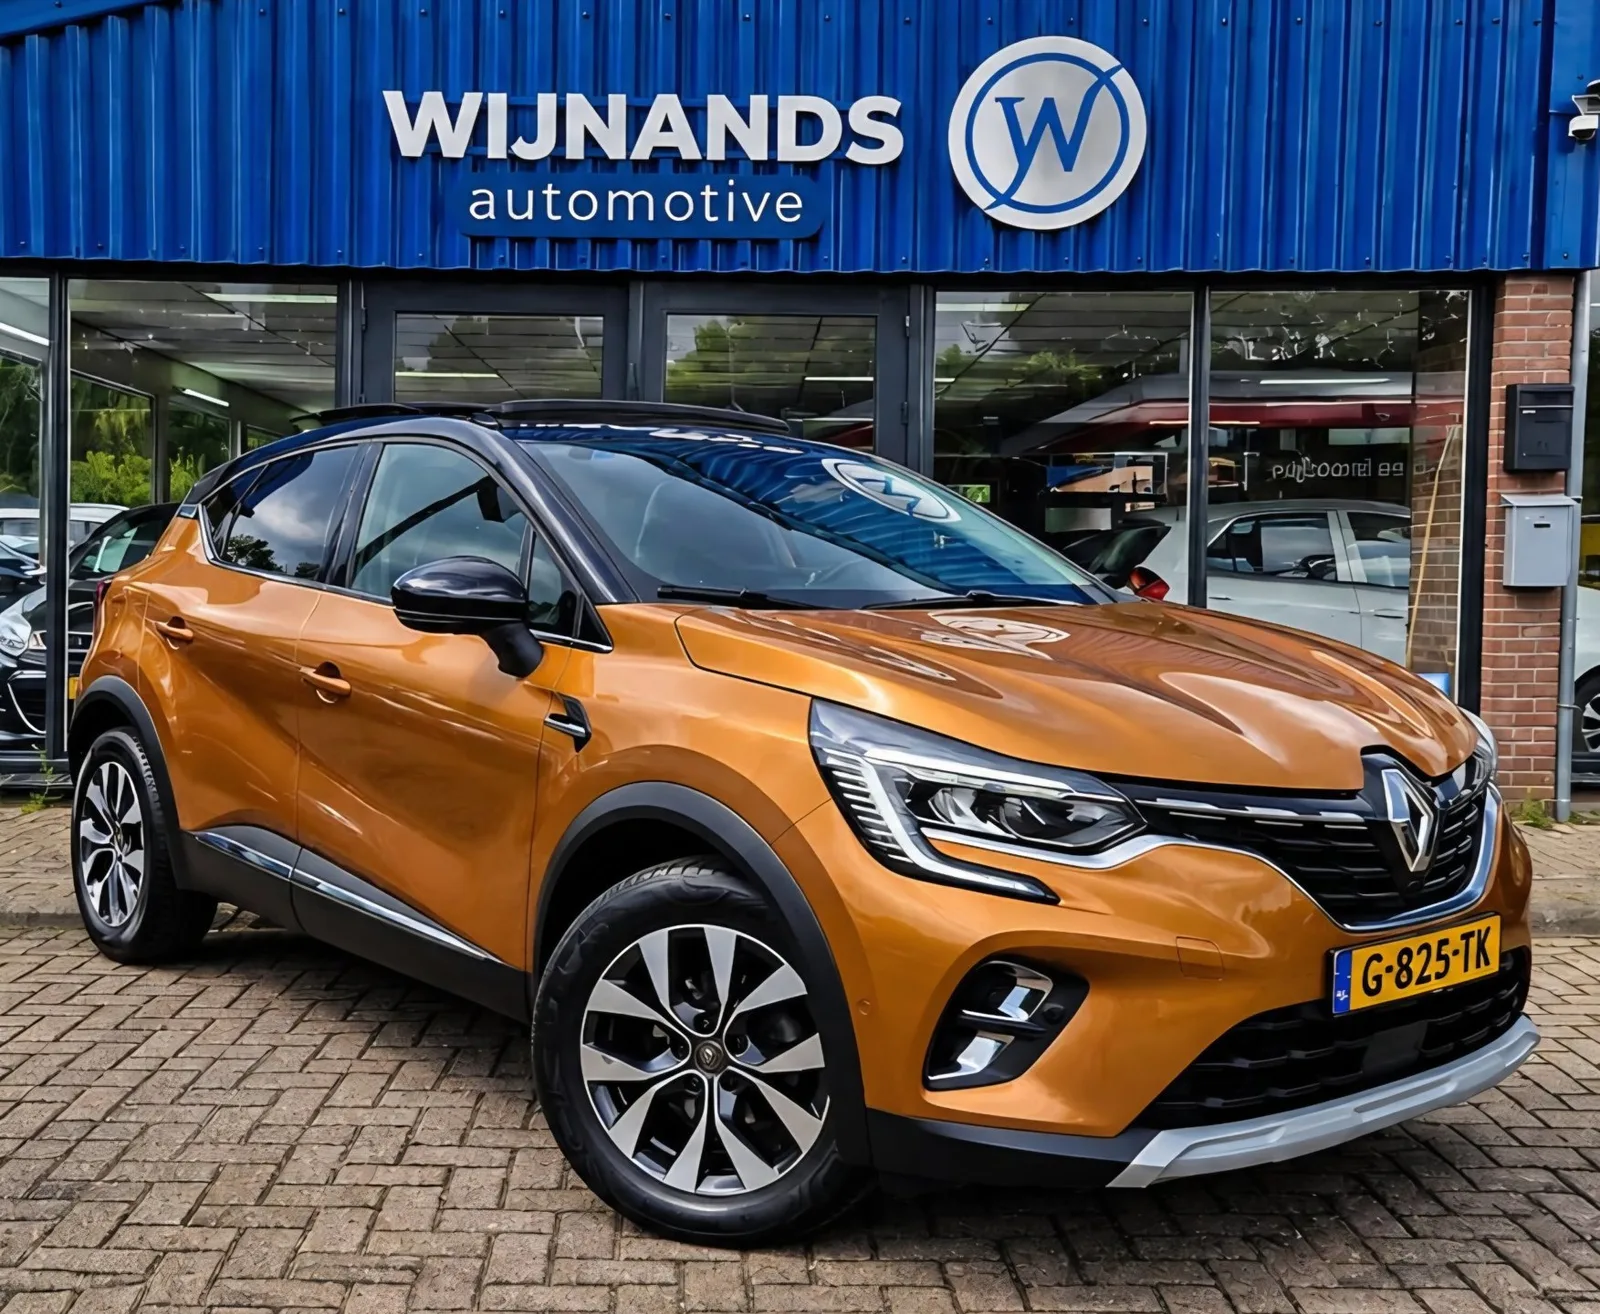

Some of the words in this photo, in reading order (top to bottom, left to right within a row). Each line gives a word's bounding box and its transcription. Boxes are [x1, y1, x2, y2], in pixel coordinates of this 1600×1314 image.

[382, 90, 904, 165] WIJNANDS
[468, 178, 804, 223] automotive
[1361, 926, 1492, 997] G-825-TK
